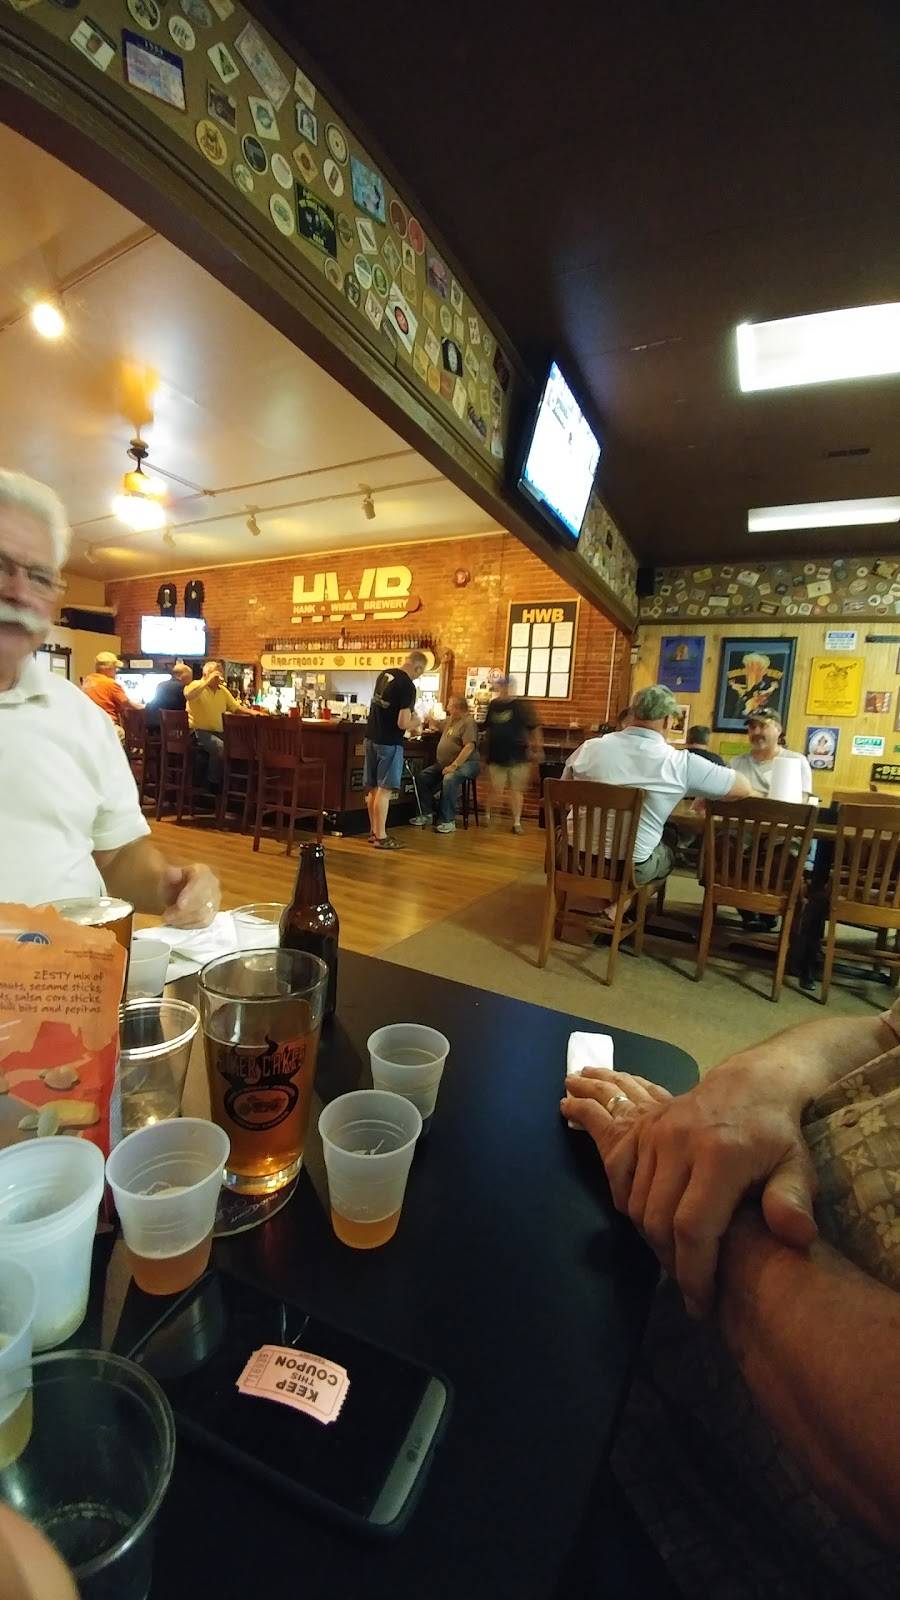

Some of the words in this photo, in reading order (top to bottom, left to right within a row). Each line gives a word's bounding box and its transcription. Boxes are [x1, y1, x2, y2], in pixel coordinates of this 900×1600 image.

[363, 599, 408, 610] BREWERY
[522, 607, 564, 623] HWB
[354, 656, 372, 666] ICE
[382, 656, 410, 666] CRE
[33, 969, 71, 980] ZESTY
[73, 970, 91, 980] mix
[93, 970, 103, 981] of
[30, 983, 69, 992] sesame
[15, 992, 42, 1002] salsa
[45, 994, 67, 1002] corn
[41, 1004, 61, 1013] and
[65, 1004, 101, 1015] pepitas
[274, 1354, 338, 1387] COUPON
[291, 1371, 315, 1387] THIS
[276, 1379, 319, 1403] KEEP
